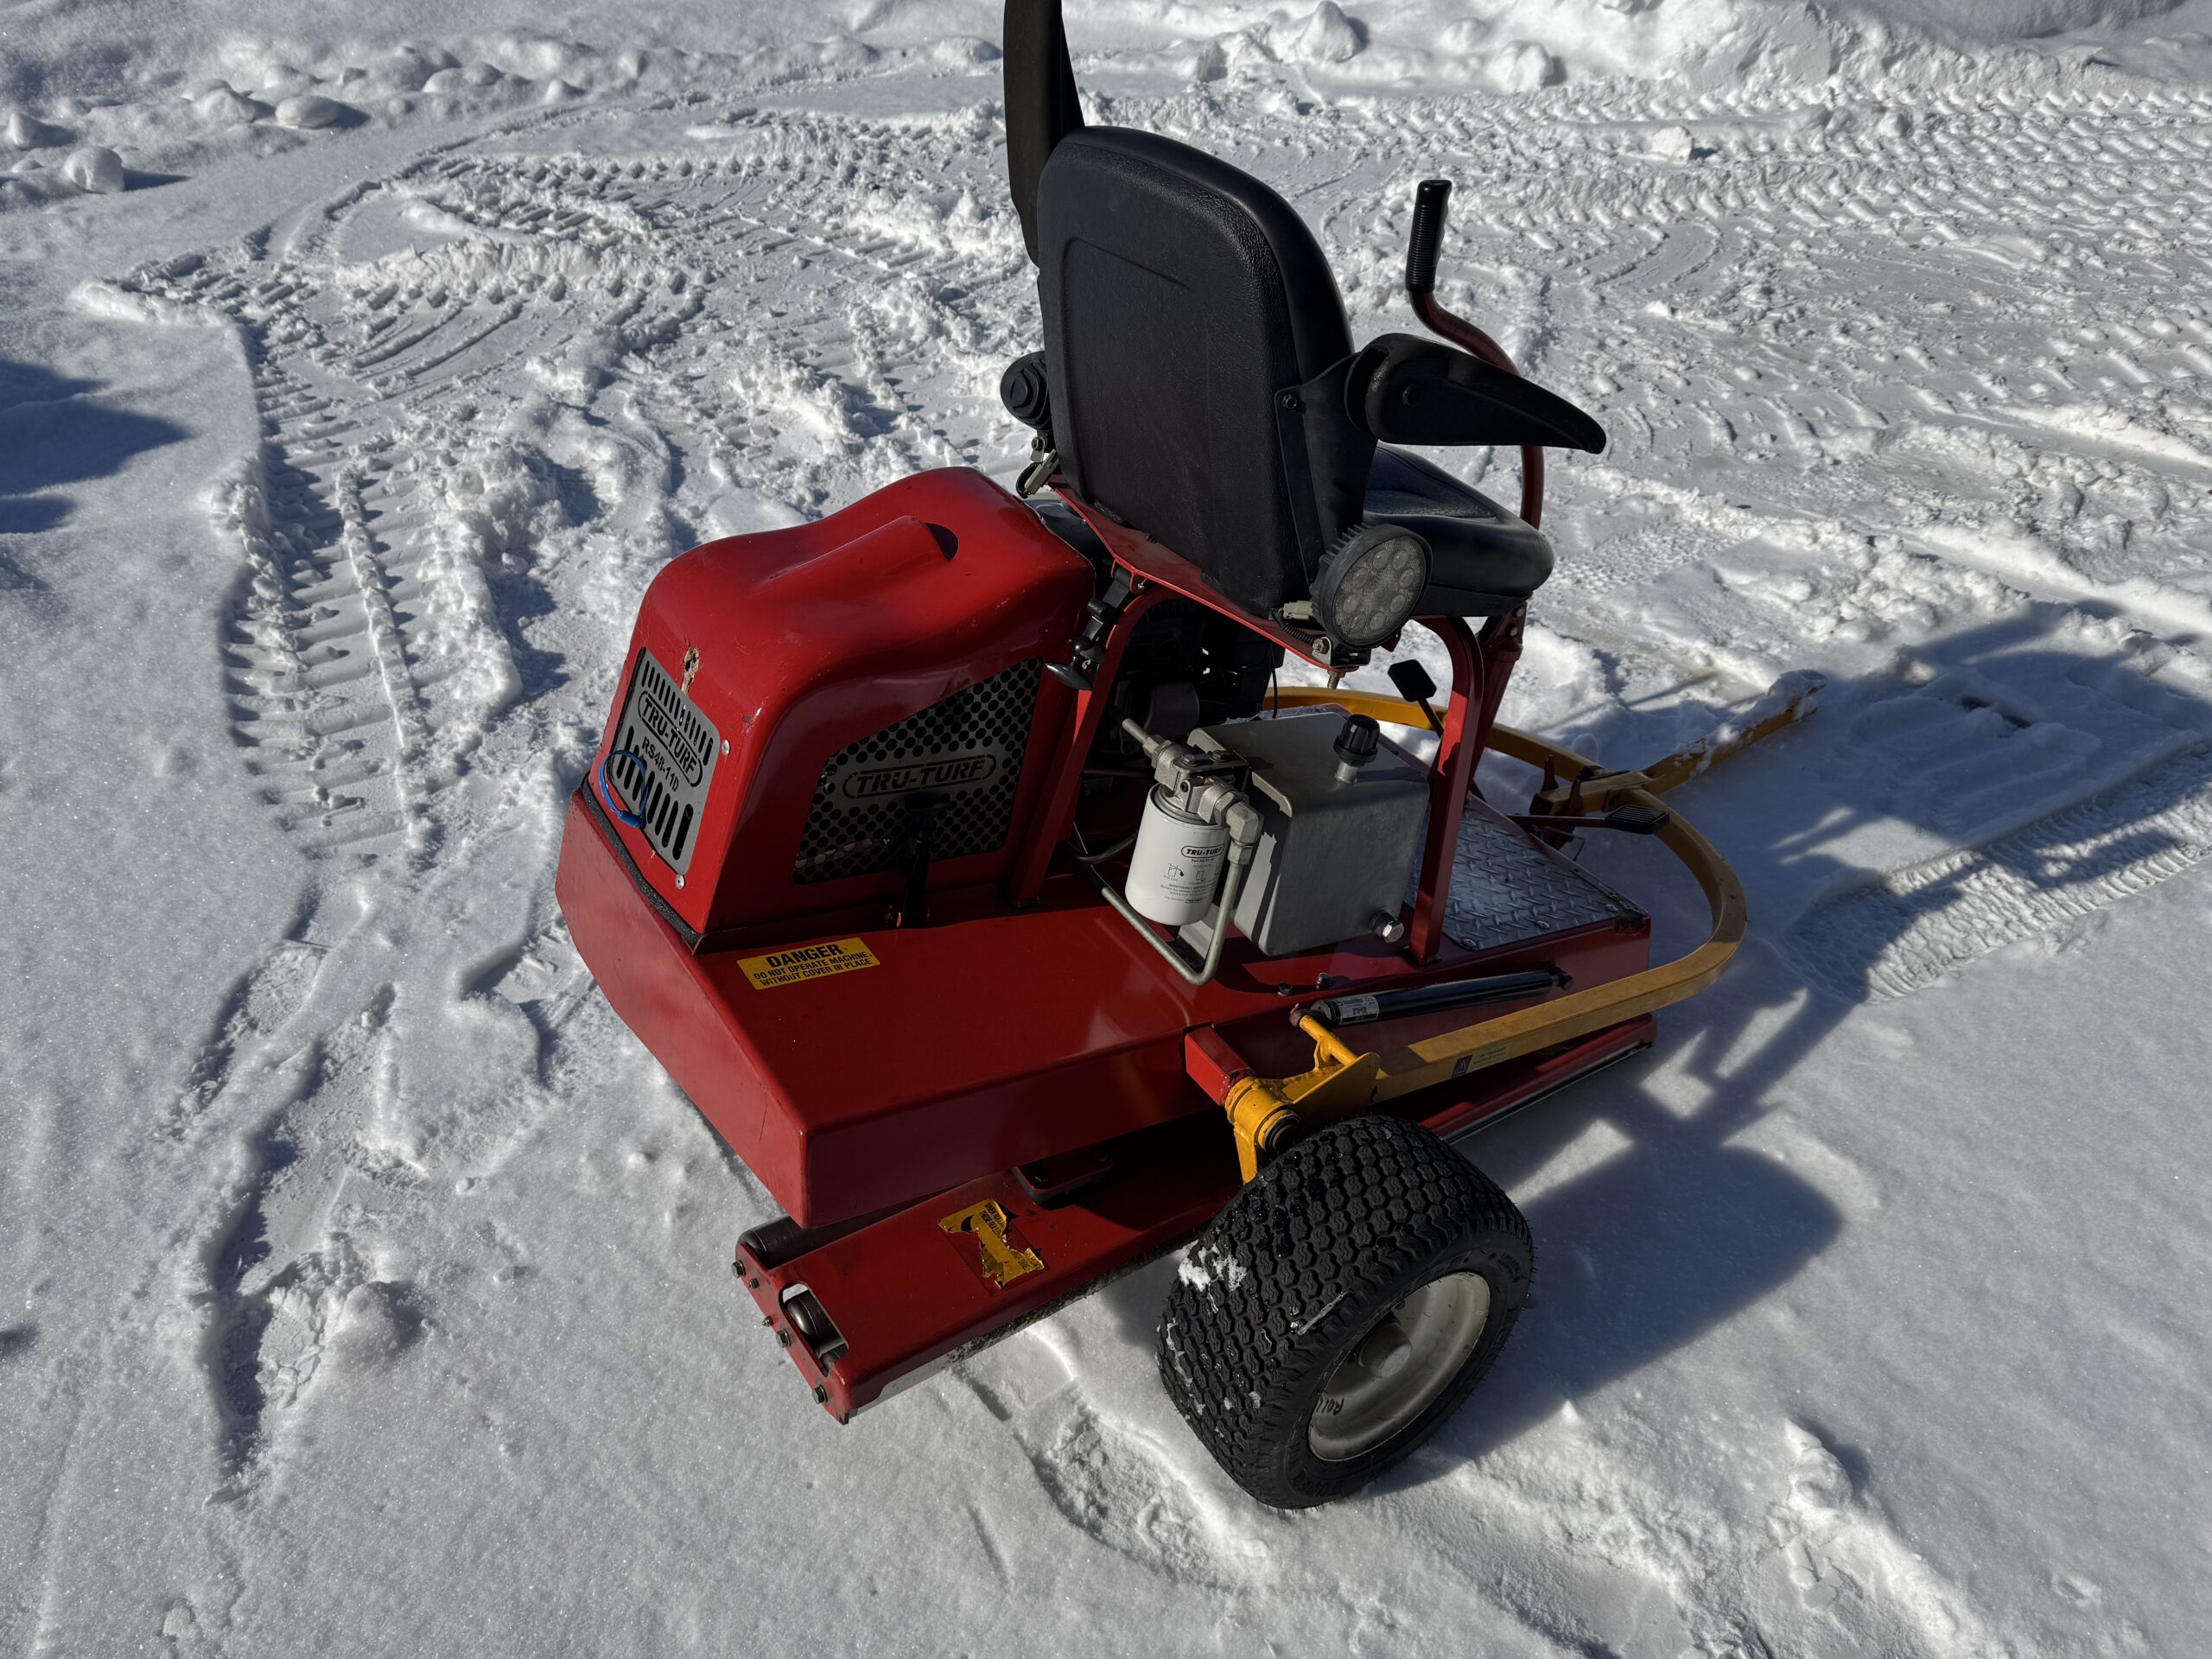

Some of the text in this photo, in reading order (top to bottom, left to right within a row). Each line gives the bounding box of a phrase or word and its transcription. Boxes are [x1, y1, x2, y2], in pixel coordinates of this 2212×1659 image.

[643, 696, 698, 774] TRU-TURF
[641, 735, 680, 792] RS48-11D
[856, 759, 986, 793] TRU-TURF
[1186, 847, 1222, 855] TRU-TURF
[766, 944, 843, 968] DANGER
[768, 967, 786, 978] NOT
[788, 960, 829, 973] OPERATE
[760, 958, 872, 986] WITHOUT COVER IN PLACE
